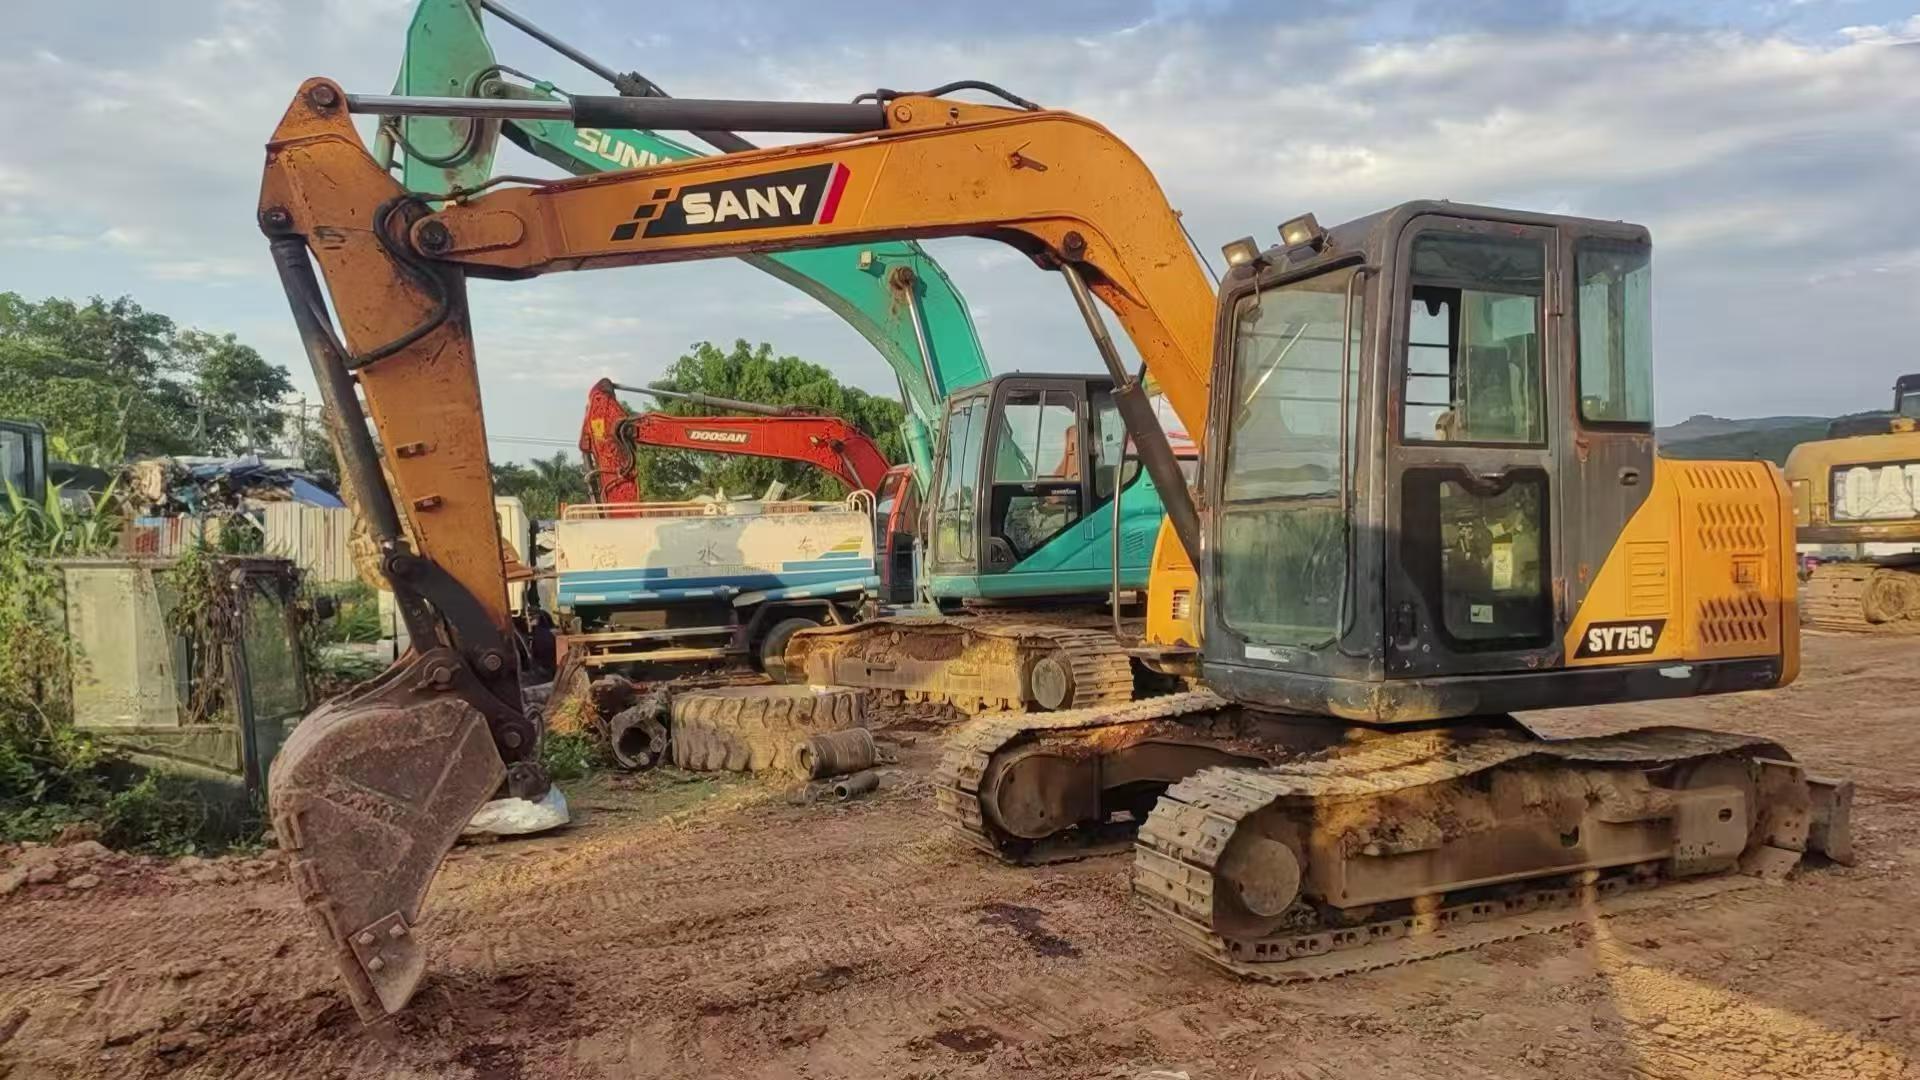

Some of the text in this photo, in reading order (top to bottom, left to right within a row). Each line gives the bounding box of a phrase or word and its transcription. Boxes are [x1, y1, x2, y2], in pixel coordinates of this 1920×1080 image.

[682, 184, 807, 225] SANY
[690, 430, 747, 443] DOOSAN
[1588, 625, 1653, 652] SY75C
